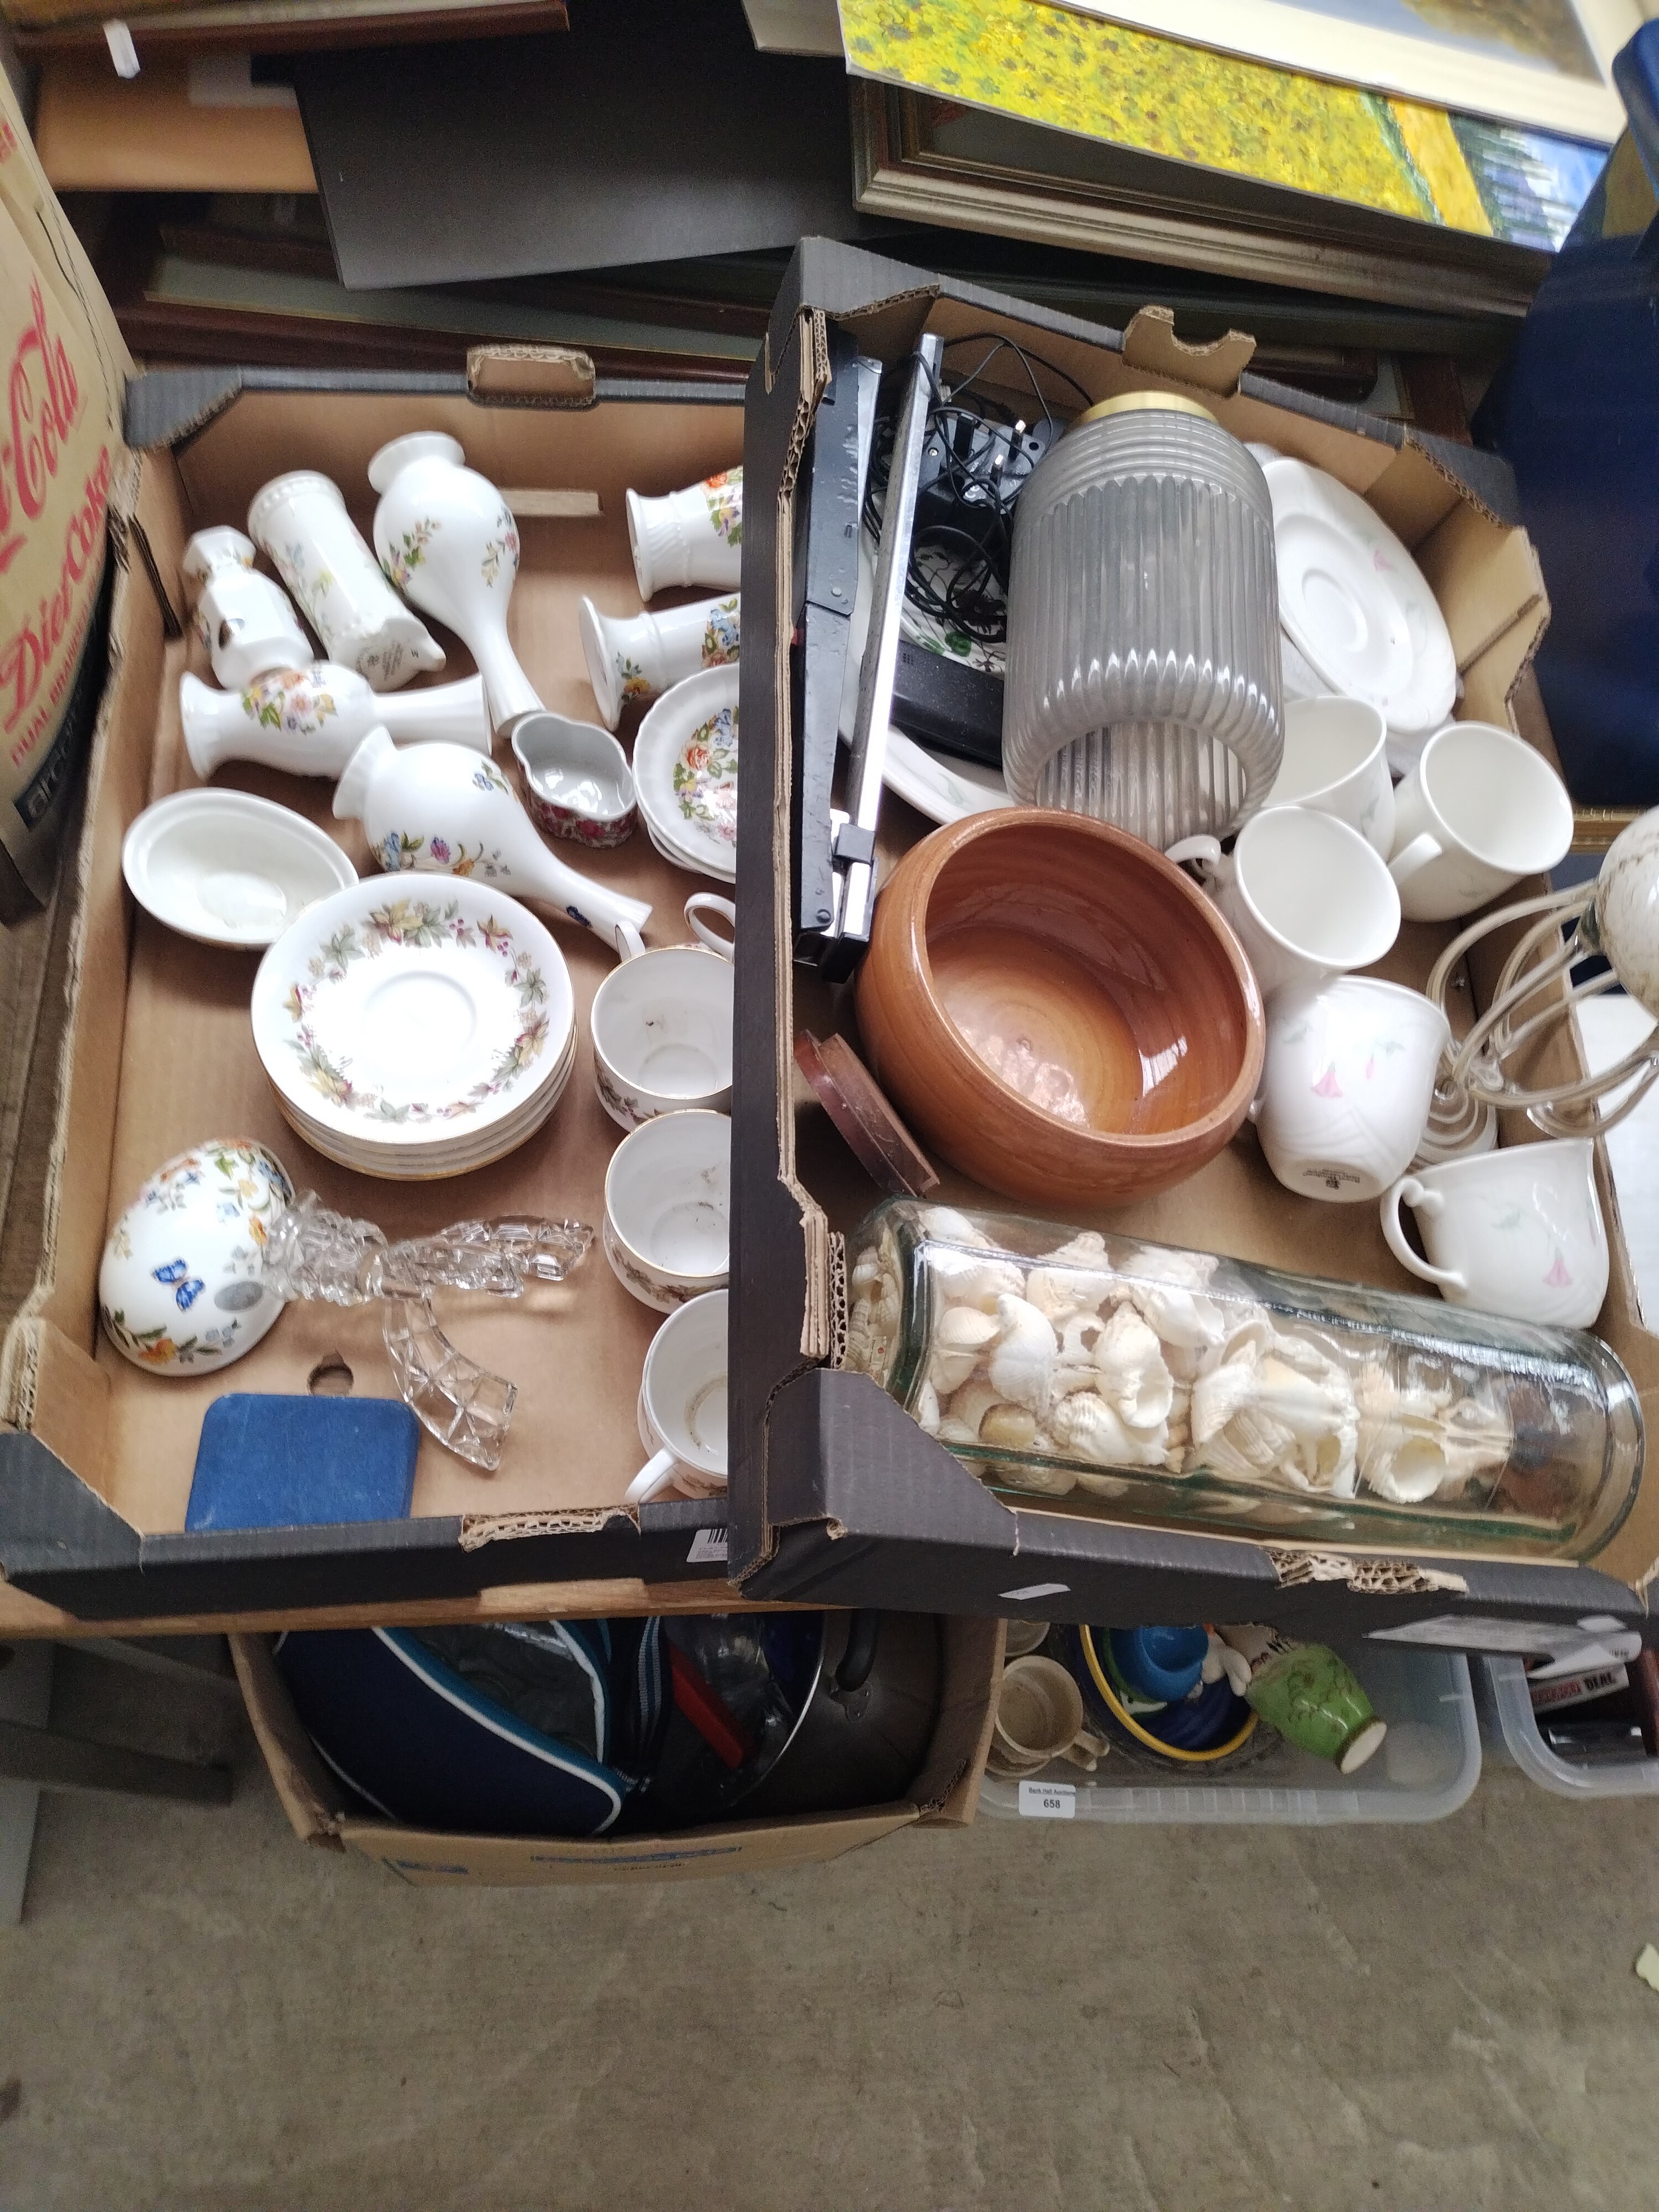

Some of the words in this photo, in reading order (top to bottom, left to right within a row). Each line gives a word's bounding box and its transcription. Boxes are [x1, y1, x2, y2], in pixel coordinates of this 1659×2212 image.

[0, 561, 72, 734] Diet
[11, 705, 52, 769] DUAL
[1043, 1799, 1060, 1808] 658
